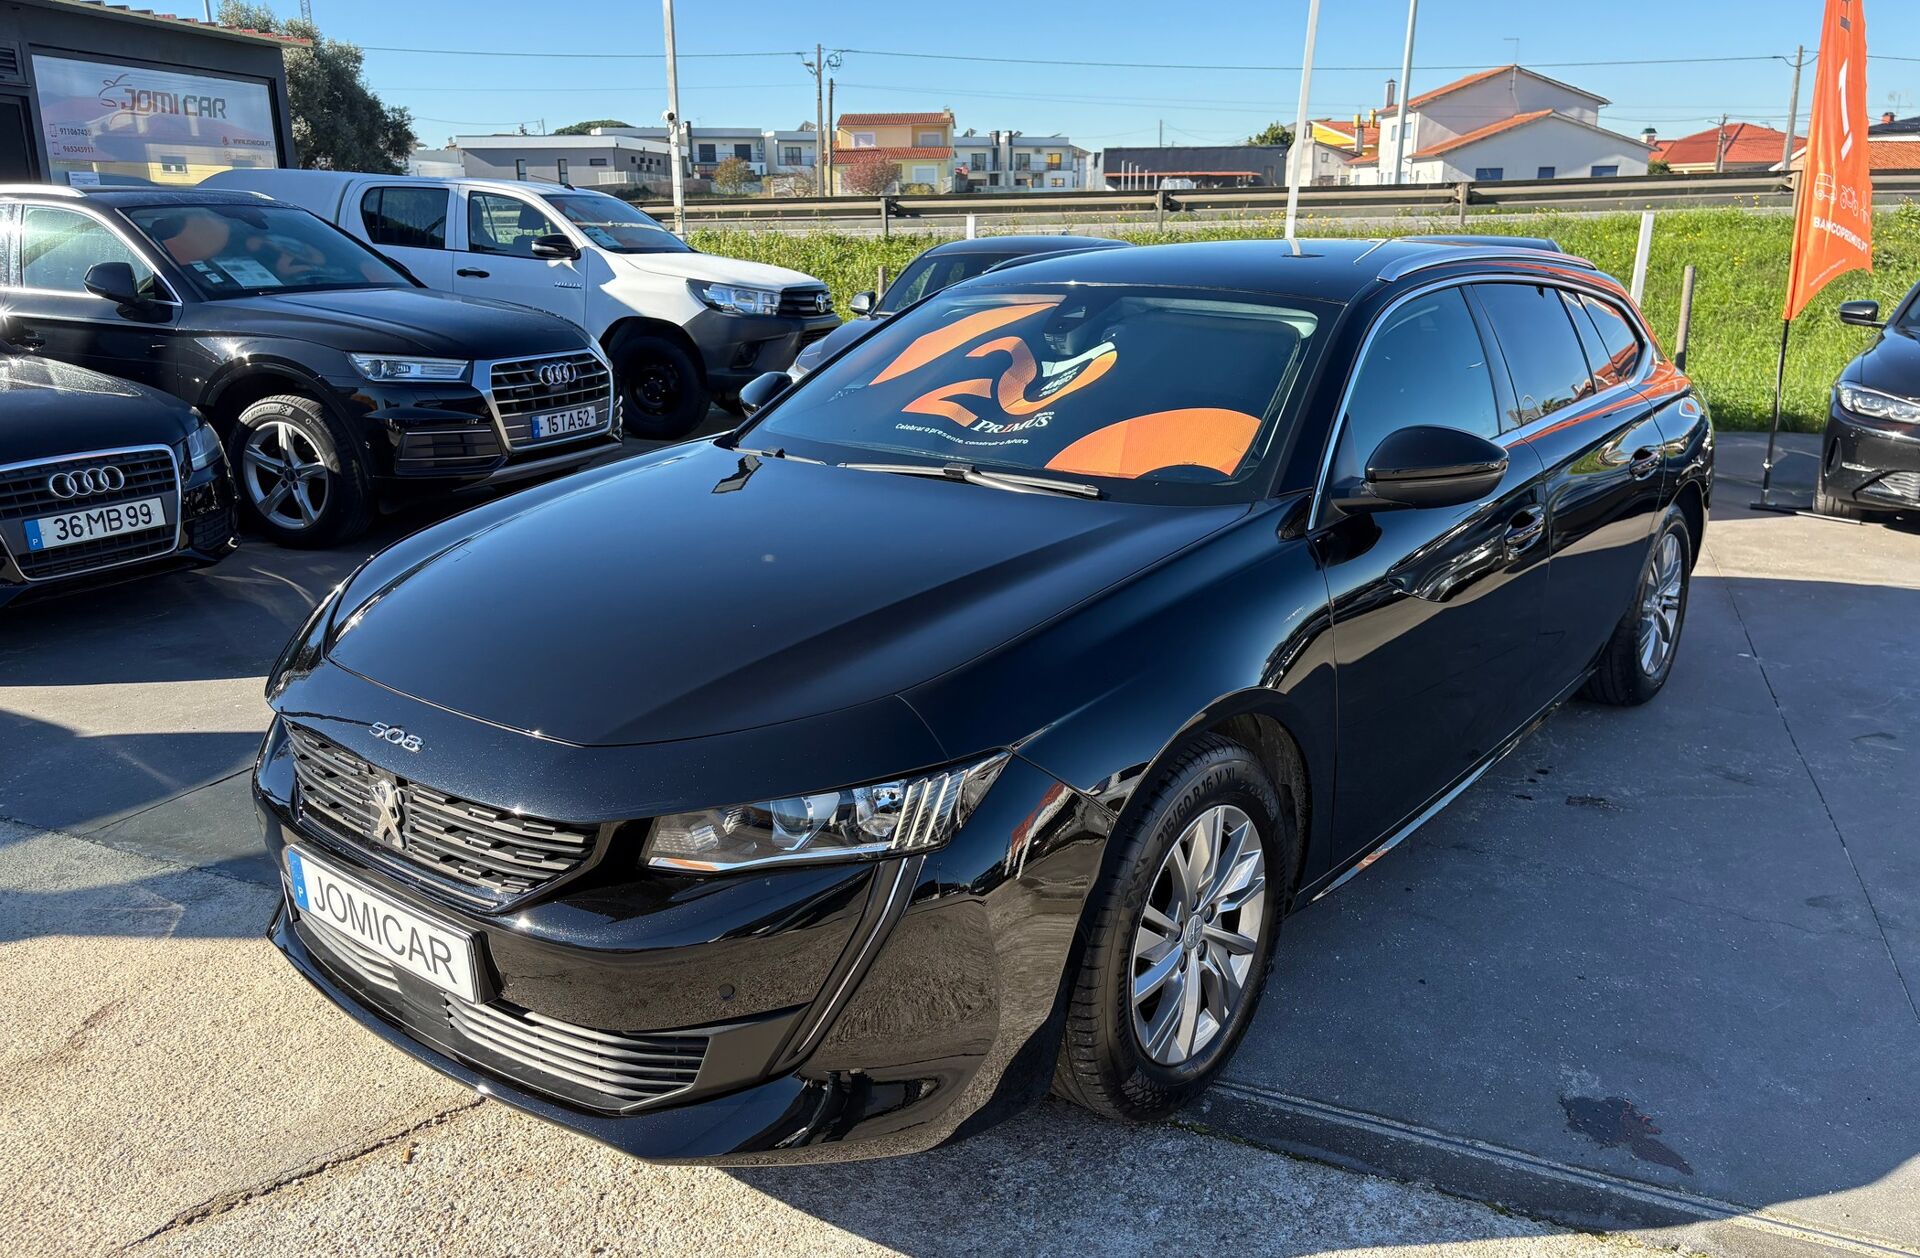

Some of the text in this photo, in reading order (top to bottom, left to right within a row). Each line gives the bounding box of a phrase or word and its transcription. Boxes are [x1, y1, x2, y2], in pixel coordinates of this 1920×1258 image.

[120, 88, 227, 119] JOMI CAR
[368, 721, 425, 753] 508
[297, 885, 304, 898] P
[314, 876, 458, 984] JOMICAR
